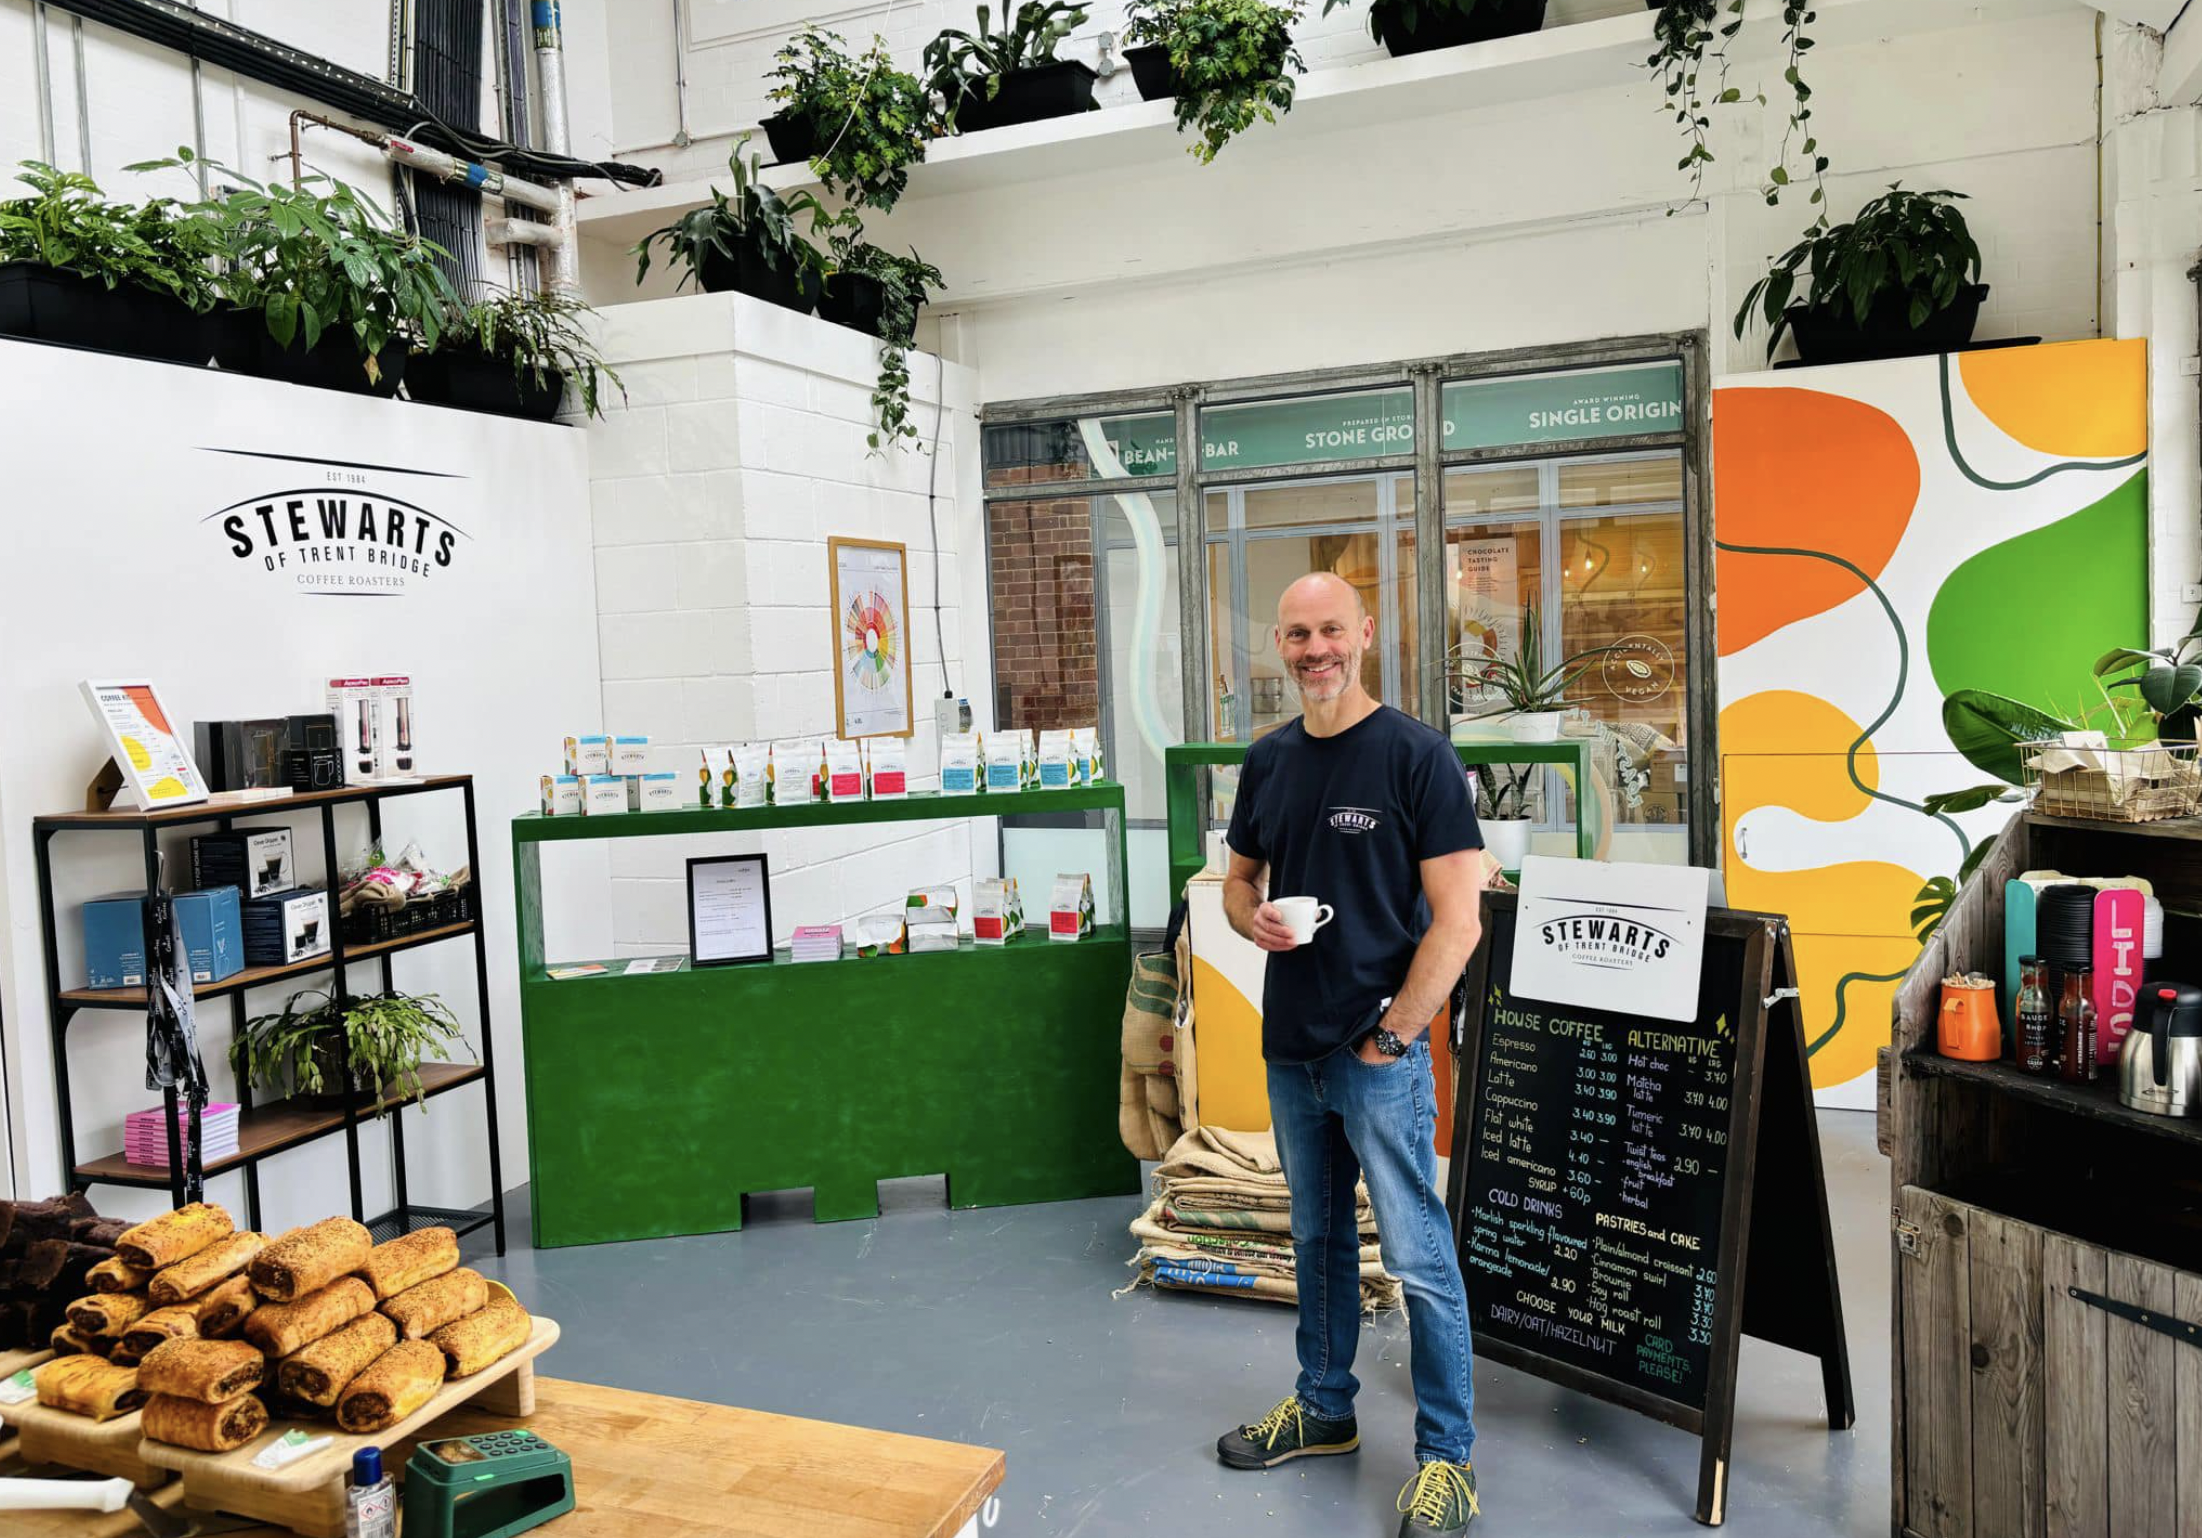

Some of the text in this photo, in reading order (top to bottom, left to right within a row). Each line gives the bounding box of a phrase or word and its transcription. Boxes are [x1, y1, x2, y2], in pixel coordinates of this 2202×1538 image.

[1573, 393, 1640, 405] AWARD WINNING
[1529, 400, 1682, 428] SINGLE ORIGIN
[1305, 420, 1455, 448] STONE GROD
[1125, 441, 1239, 465] BEAN--BAR
[327, 471, 342, 482] EST
[224, 499, 455, 567] STEWARTS
[264, 546, 430, 578] OF TRENT BRIDGE
[1467, 547, 1509, 555] CHOCOLATE
[297, 574, 405, 587] COFFEE ROASTERS
[1626, 681, 1659, 695] VEGAN
[1330, 814, 1376, 829] STEWARTS
[1542, 920, 1670, 958] STEWARTS
[1558, 941, 1651, 963] OF TRENT BRIDGE
[1494, 1008, 1604, 1042] HOUSE COFFEE
[1492, 1033, 1536, 1053] Espresso
[1628, 1030, 1721, 1059] ALTERNATIVE
[1490, 1051, 1617, 1083] Americano 3.00 3.00
[1628, 1053, 1648, 1068] Hot
[1650, 1056, 1669, 1072] choc
[1488, 1068, 1515, 1087] Latte
[1574, 1083, 1595, 1096] 3.40
[1626, 1074, 1661, 1091] Matcha
[1485, 1087, 1538, 1111] Cappuccino
[1572, 1107, 1595, 1120] 3.40
[1633, 1087, 1653, 1102] latte
[1708, 1095, 1728, 1110] 4.00
[1626, 1104, 1663, 1124] Tumeric
[1485, 1108, 1594, 1144] Flat white 3.40
[1631, 1120, 1653, 1138] latte
[1706, 1128, 1727, 1145] 4.00
[1483, 1127, 1503, 1144] Iced
[1509, 1132, 1532, 1153] latte
[1624, 1141, 1666, 1162] Twist teas
[1481, 1145, 1591, 1185] Iced americano 3.60
[1626, 1158, 1652, 1171] english
[1528, 1177, 1557, 1192] SYRUP
[1624, 1176, 1644, 1190] fruit
[1638, 1169, 1675, 1188] breakfast
[1488, 1188, 1563, 1219] COLD DRINKS
[1622, 1191, 1648, 1209] herbal
[1473, 1225, 1526, 1247] spring water
[1475, 1205, 1588, 1250] Marlish sparkling flavoured
[1596, 1212, 1701, 1250] PASTRIES and CAKE
[1471, 1236, 1500, 1258] Karma
[1469, 1255, 1513, 1278] orangeade
[1593, 1253, 1638, 1277] Cinnamon
[1644, 1272, 1667, 1288] swirl
[1653, 1259, 1694, 1278] croissant
[1592, 1267, 1632, 1291] Brownie
[1591, 1281, 1607, 1300] Soy
[1613, 1290, 1629, 1301] roll
[1516, 1290, 1626, 1336] CHOOSE YOUR MILK
[1589, 1296, 1608, 1319] Hog
[1612, 1307, 1641, 1322] roast
[1644, 1315, 1661, 1330] roll
[1645, 1333, 1673, 1351] CARD
[1639, 1361, 1683, 1384] PLEASE!
